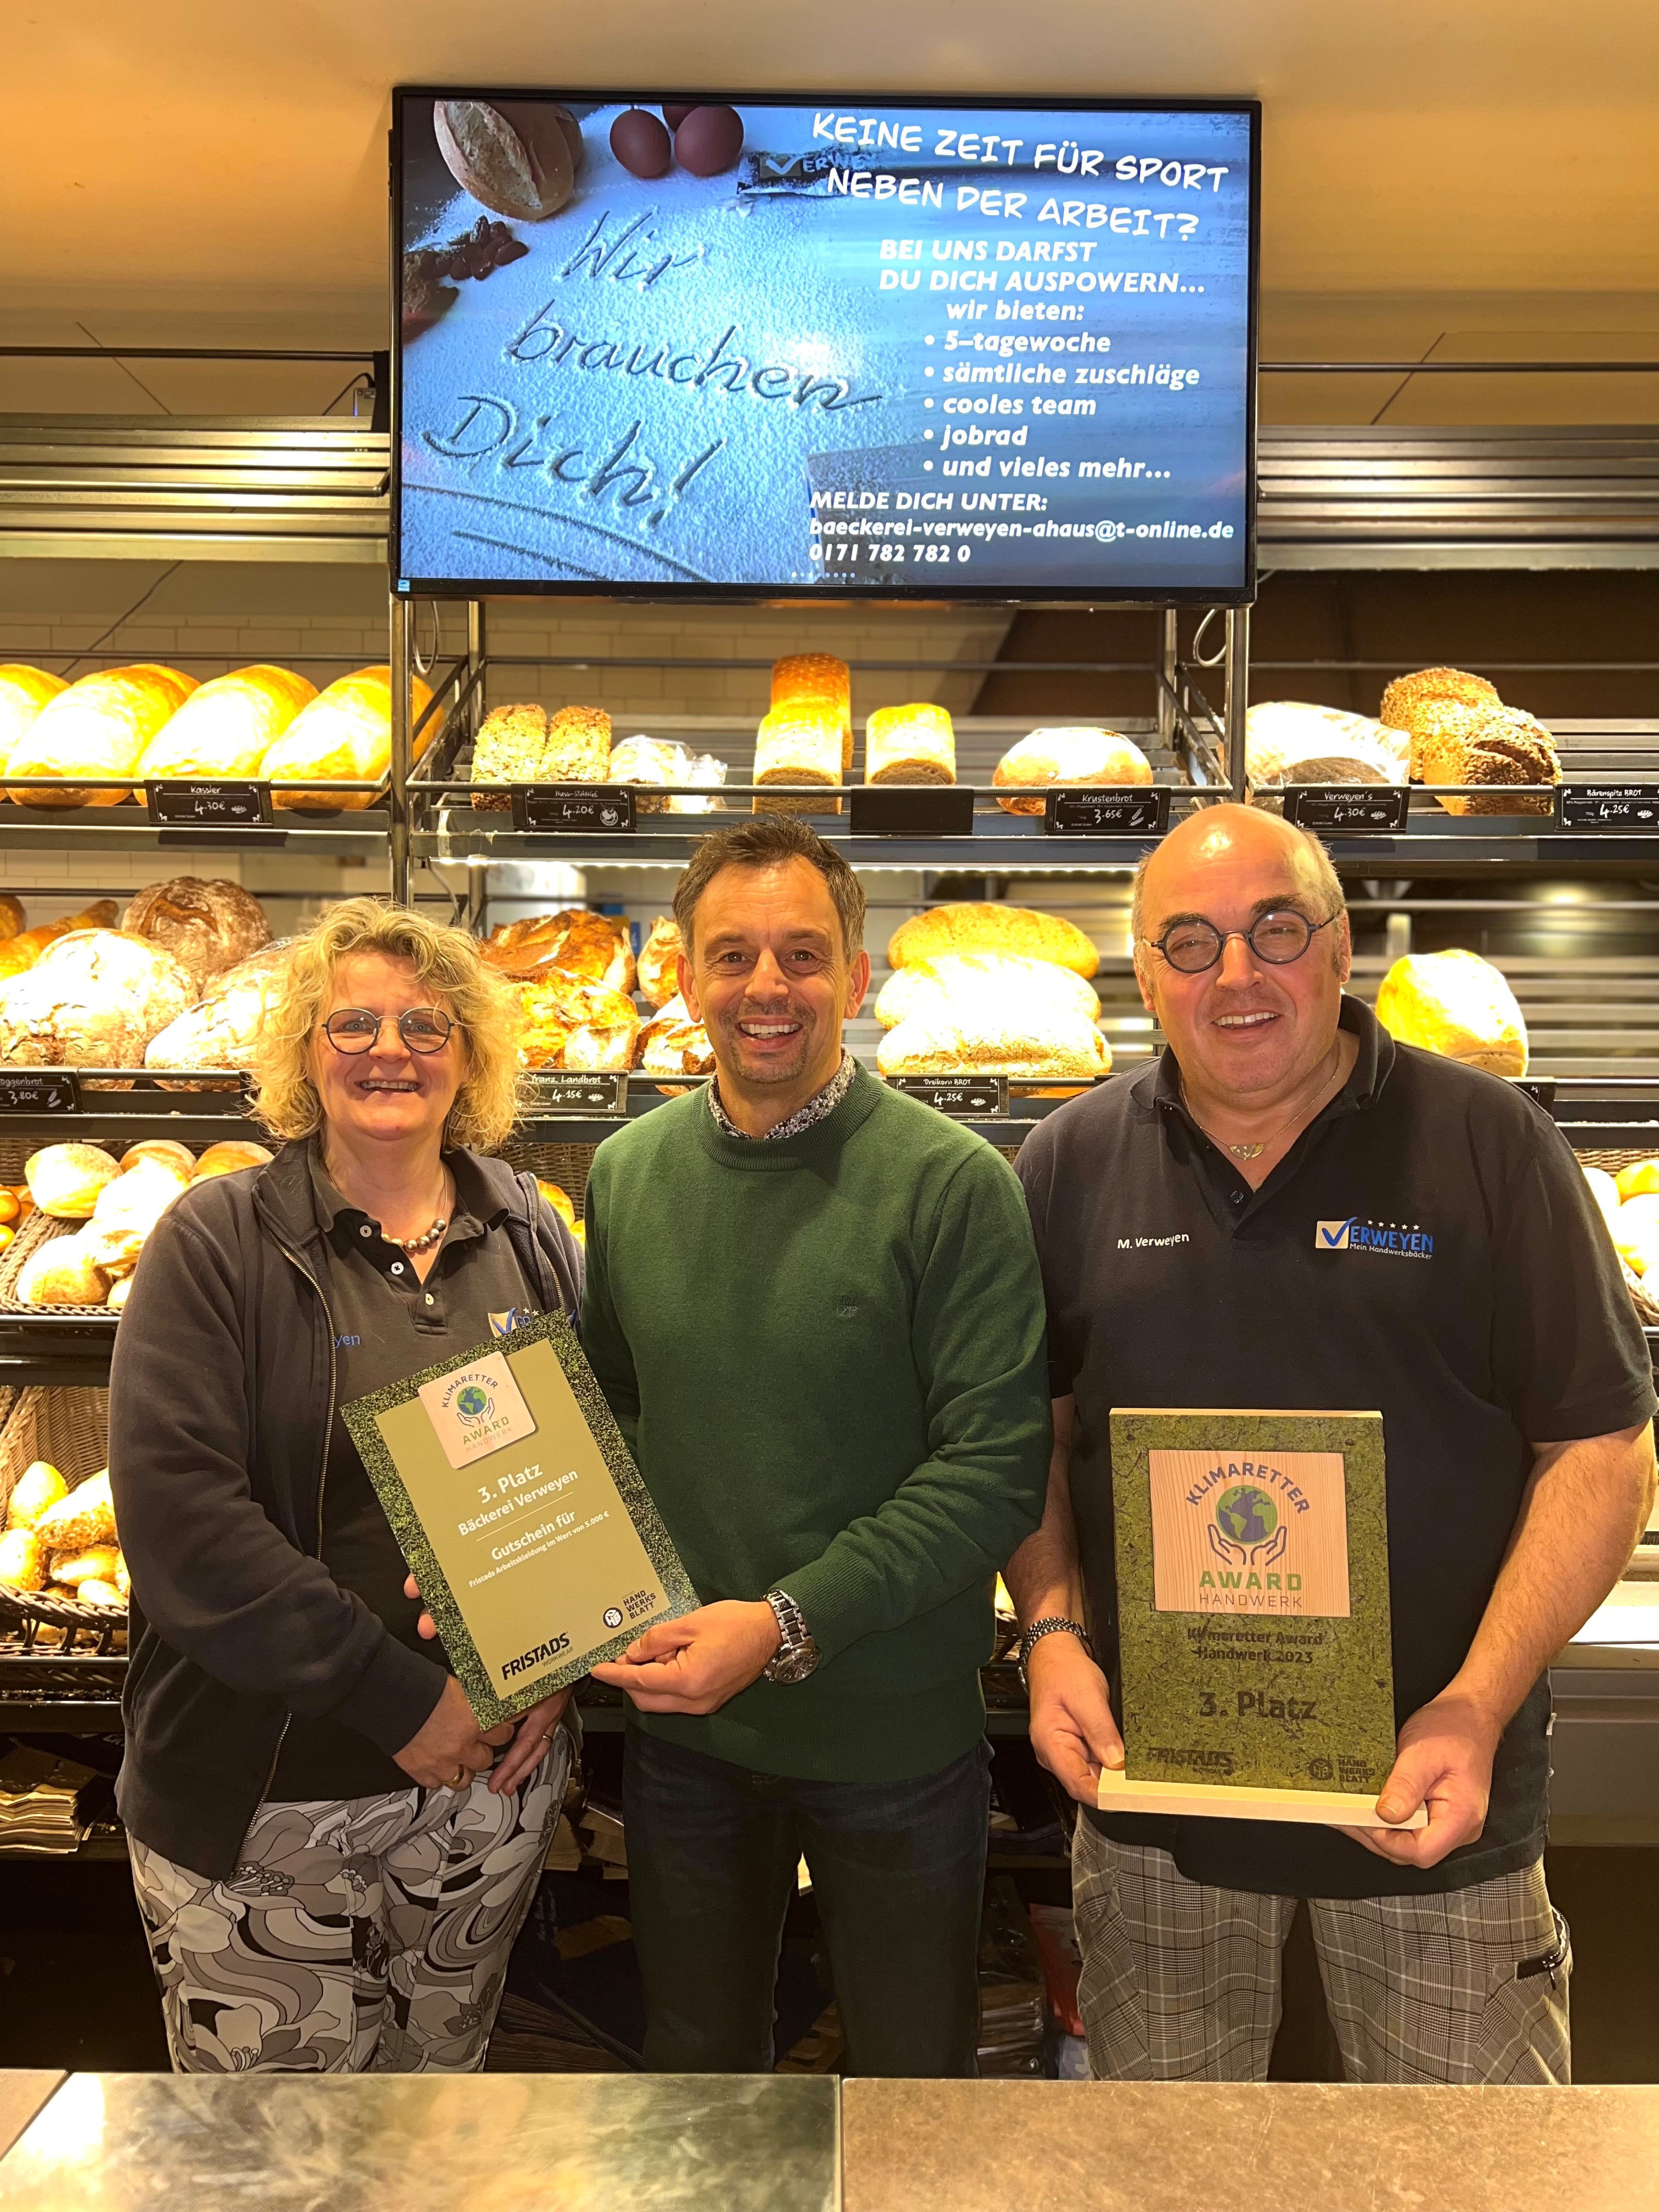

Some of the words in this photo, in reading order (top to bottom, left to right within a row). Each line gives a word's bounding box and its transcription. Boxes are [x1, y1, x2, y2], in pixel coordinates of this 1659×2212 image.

[812, 112, 923, 153] KEINE
[935, 129, 1023, 166] ZEIT
[1034, 141, 1104, 177] FÜR
[1115, 156, 1229, 193] SPORT
[827, 168, 944, 208] NEBEN
[956, 187, 1028, 219] DER
[1037, 199, 1200, 241] ARBEIT?
[560, 208, 704, 285] Wir
[879, 240, 922, 261] BEI
[931, 240, 988, 262] UNS
[996, 241, 1098, 263] DARFST
[879, 269, 921, 291] DU
[929, 270, 997, 292] DICH
[1005, 271, 1205, 294] AUSPOWERN...
[946, 302, 989, 321] wir
[995, 300, 1085, 322] bieten:
[505, 300, 882, 410] brauchen
[943, 364, 1067, 386] sämtliche
[1075, 364, 1200, 391] zuschläge
[943, 395, 1023, 416] cooles
[1031, 398, 1097, 416] team
[941, 426, 1028, 450] jobrad
[422, 395, 726, 527] Dich!
[943, 458, 993, 477] und
[999, 456, 1070, 477] vieles
[1079, 459, 1171, 478] mehr...
[809, 492, 889, 509] MELDE
[896, 493, 954, 510] DICH
[961, 493, 1048, 512] UNTER:
[809, 518, 1235, 542] baeckerei-verweyen-ahaus@t-online.de
[809, 544, 860, 562] 0171
[868, 545, 905, 562] 782
[913, 545, 950, 563] 782
[957, 545, 971, 563] 0
[190, 784, 222, 794] Kassler
[1082, 792, 1133, 803] Krustenbrot
[1587, 789, 1623, 799] Bärenspitz
[195, 800, 226, 815] 4.30€
[562, 804, 594, 819] 4.20€
[1094, 809, 1123, 824] 3.65€
[1334, 806, 1366, 822] 4.30€
[1599, 804, 1630, 819] 4.25€
[561, 1074, 602, 1084] Landbrot
[8, 1090, 39, 1105] 3.80€
[551, 1089, 583, 1103] 4.15€
[934, 1091, 963, 1106] 4.25€
[1117, 1239, 1133, 1249] M.
[1135, 1234, 1190, 1247] Verweyen
[1350, 1243, 1367, 1251] Mein
[1369, 1245, 1432, 1260] Handwerksbäcker
[442, 1374, 498, 1408] KLIMARETTER
[462, 1416, 510, 1445] AWARD
[466, 1426, 514, 1452] HANDWERK
[477, 1486, 498, 1504] 3.
[497, 1464, 543, 1493] Platz
[1186, 1462, 1310, 1514] KLIMARETTER
[458, 1499, 515, 1536] Bäckerei
[514, 1470, 579, 1506] Verweyen
[491, 1523, 556, 1560] Gutschein
[555, 1511, 575, 1528] für
[469, 1570, 496, 1588] Fristads
[495, 1544, 548, 1575] Arbeitskleidung
[546, 1539, 556, 1548] im
[555, 1530, 573, 1543] Wert
[572, 1523, 585, 1534] von
[584, 1515, 604, 1528] 5.000
[1199, 1570, 1302, 1591] AWARD
[623, 1590, 646, 1606] HAND
[626, 1592, 656, 1613] WERKS
[1199, 1593, 1303, 1608] HANDWERK
[629, 1601, 654, 1620] BLATT
[1275, 1631, 1323, 1645] Award
[501, 1632, 570, 1681] FRISTADS
[542, 1646, 574, 1667] WORKWEAR
[1197, 1647, 1270, 1661] Handwerk
[1274, 1651, 1313, 1664] 2023
[1199, 1691, 1228, 1718] 3.
[1237, 1691, 1318, 1720] Platz
[1338, 1758, 1368, 1767] HAND
